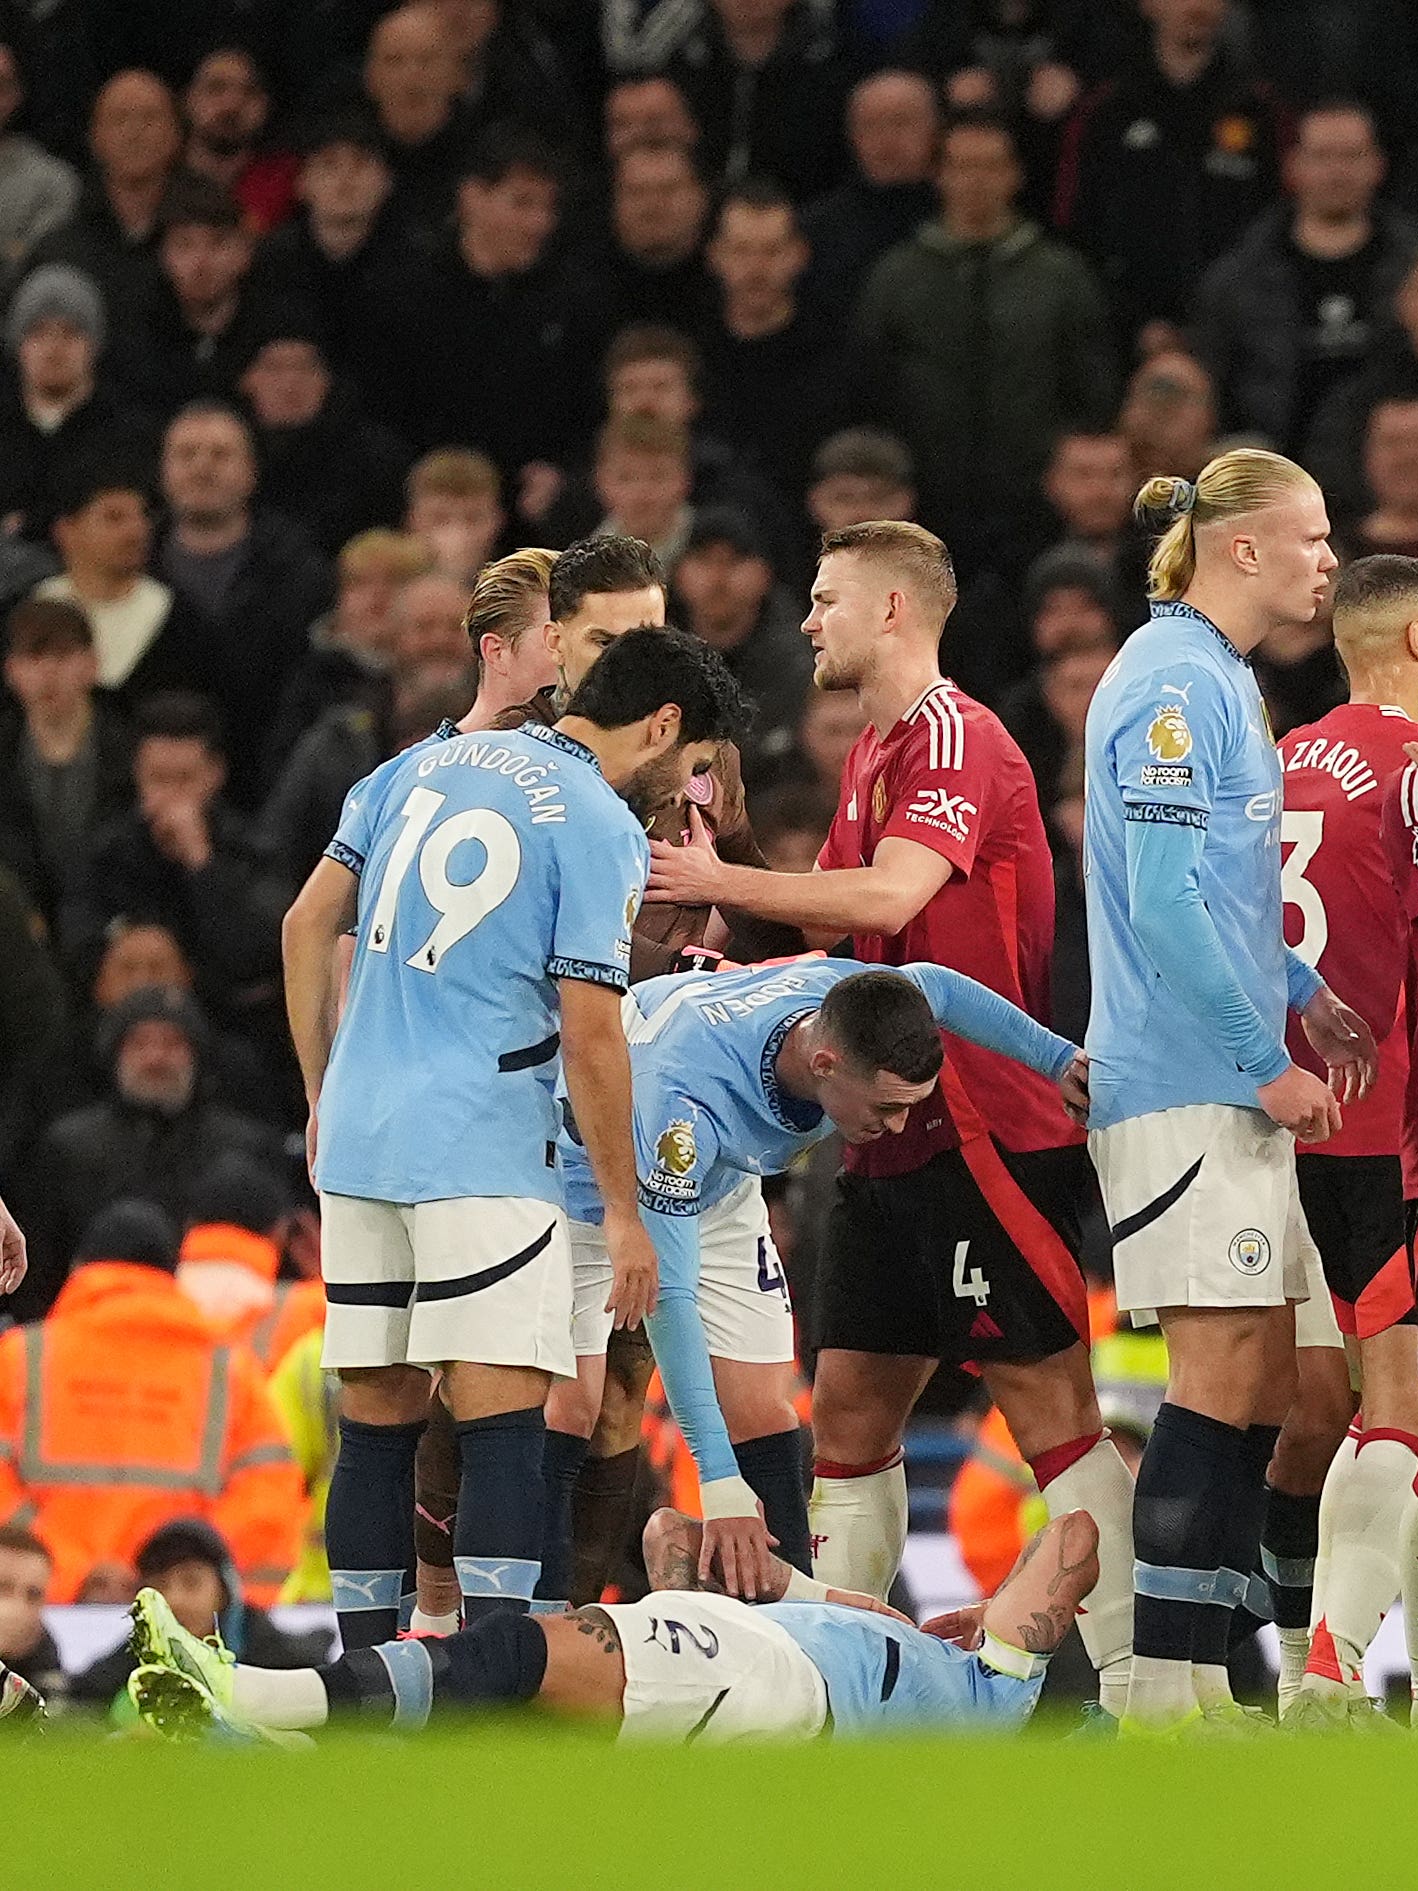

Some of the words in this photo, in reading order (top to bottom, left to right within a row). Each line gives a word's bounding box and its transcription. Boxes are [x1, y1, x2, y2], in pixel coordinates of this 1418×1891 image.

[1141, 766, 1157, 777] No
[1157, 767, 1189, 778] room
[1277, 738, 1378, 802] ZRAOUI
[908, 788, 978, 835] DXC
[368, 785, 523, 975] 19
[1280, 811, 1329, 969] 3
[664, 1175, 694, 1188] room
[952, 1239, 991, 1307] 4
[662, 1619, 719, 1659] 2
